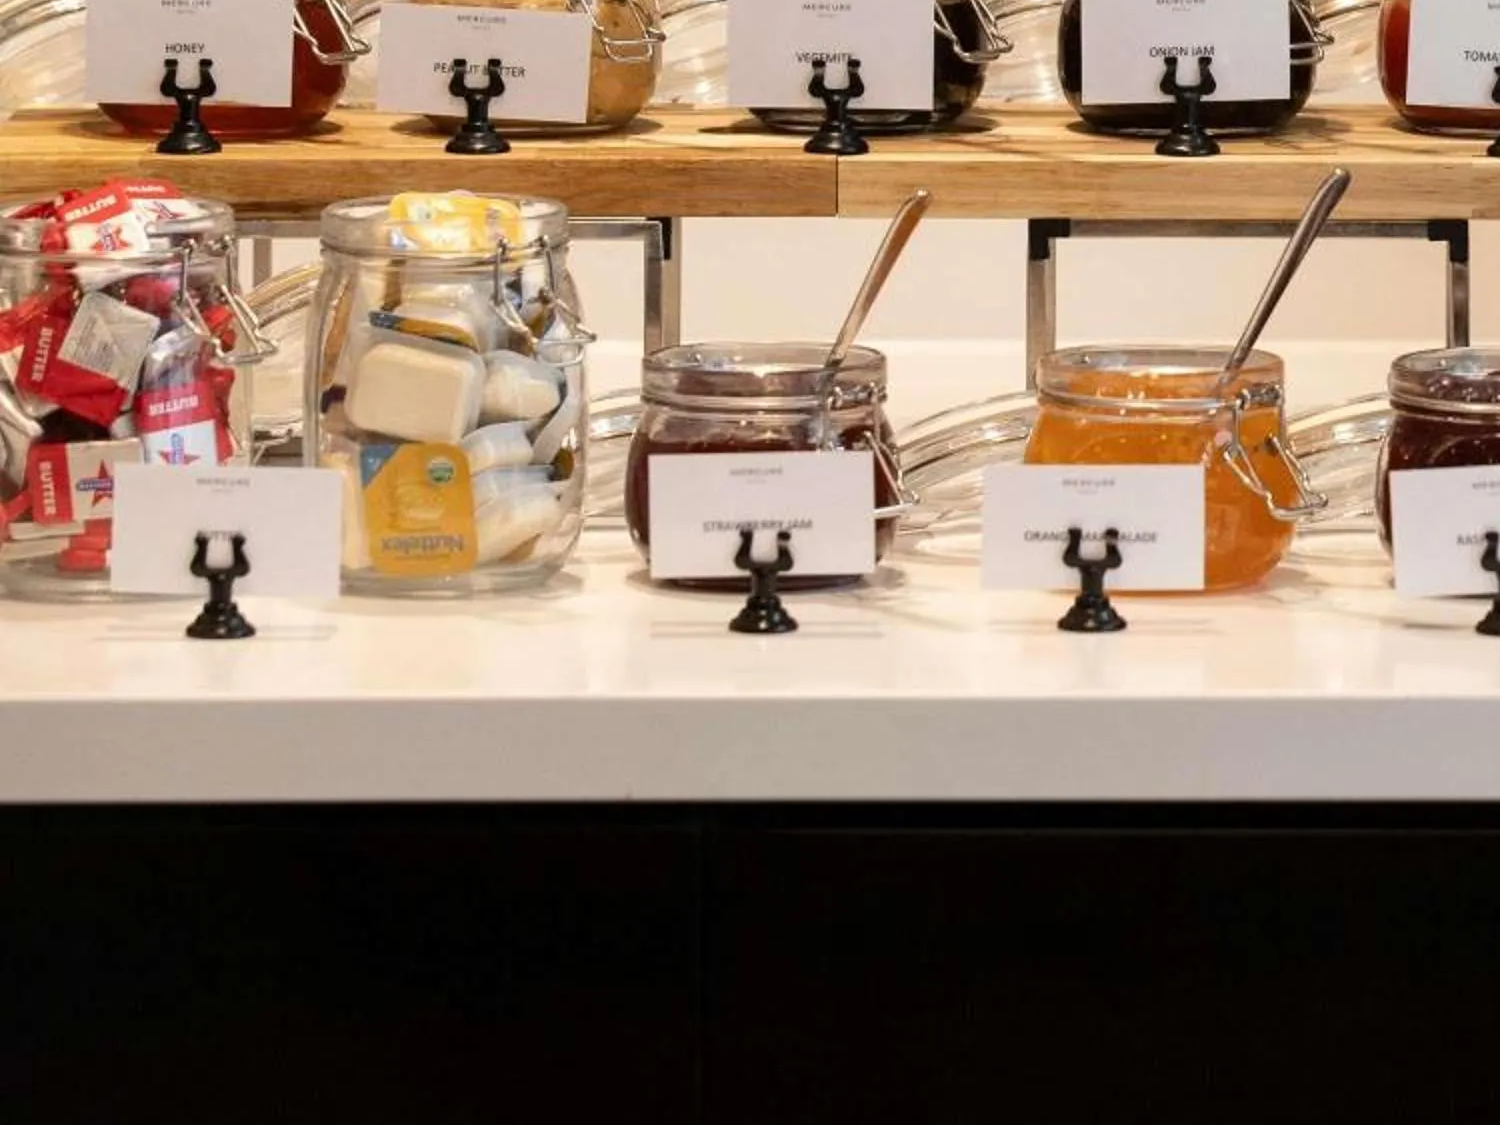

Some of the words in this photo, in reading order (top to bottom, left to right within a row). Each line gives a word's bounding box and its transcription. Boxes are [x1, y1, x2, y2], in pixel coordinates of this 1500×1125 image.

[165, 42, 205, 54] HONEY
[1149, 46, 1188, 58] ONION
[433, 61, 481, 76] PEAUT
[482, 64, 527, 78] BTTER
[31, 326, 54, 383] BUTTER
[148, 394, 199, 418] BUTTER
[38, 460, 58, 517] BUTTER
[1023, 529, 1073, 542] ORANG
